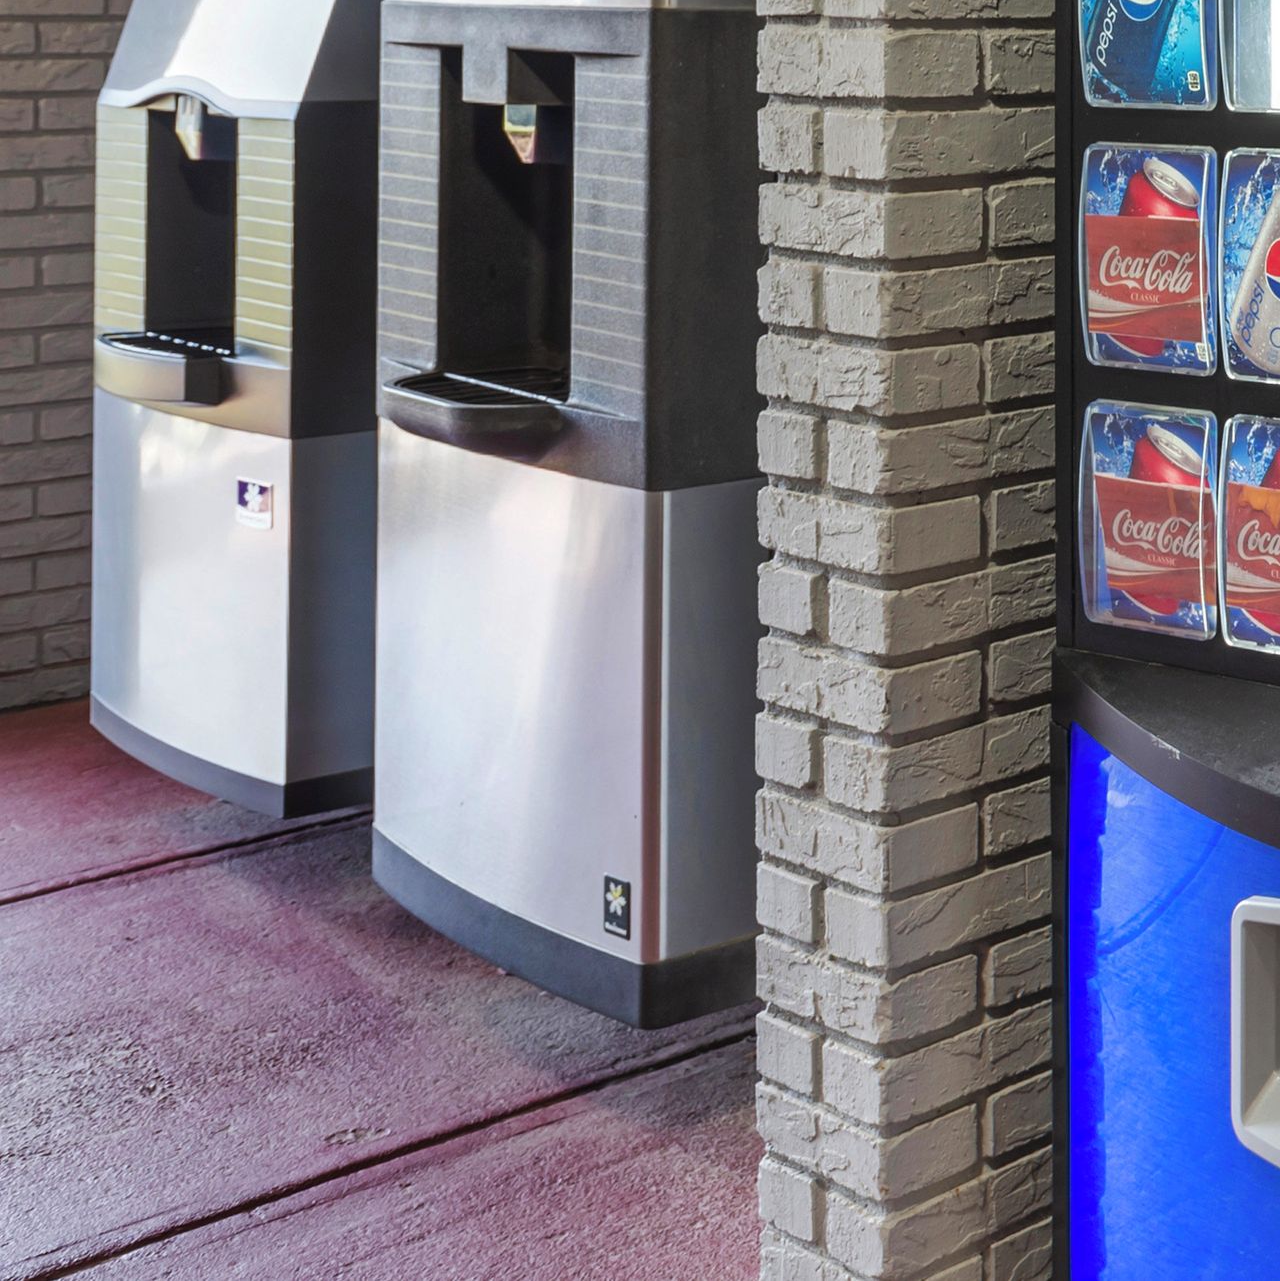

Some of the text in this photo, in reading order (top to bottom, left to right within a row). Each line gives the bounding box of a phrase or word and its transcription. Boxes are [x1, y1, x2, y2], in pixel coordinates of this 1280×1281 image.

[1095, 0, 1118, 68] pepsi
[1099, 245, 1197, 294] Coca-Cola
[1130, 292, 1160, 304] CLASSIC
[1241, 278, 1265, 349] pepsi
[1112, 508, 1210, 560] Coca-Cola
[1147, 554, 1178, 567] CLASSIC
